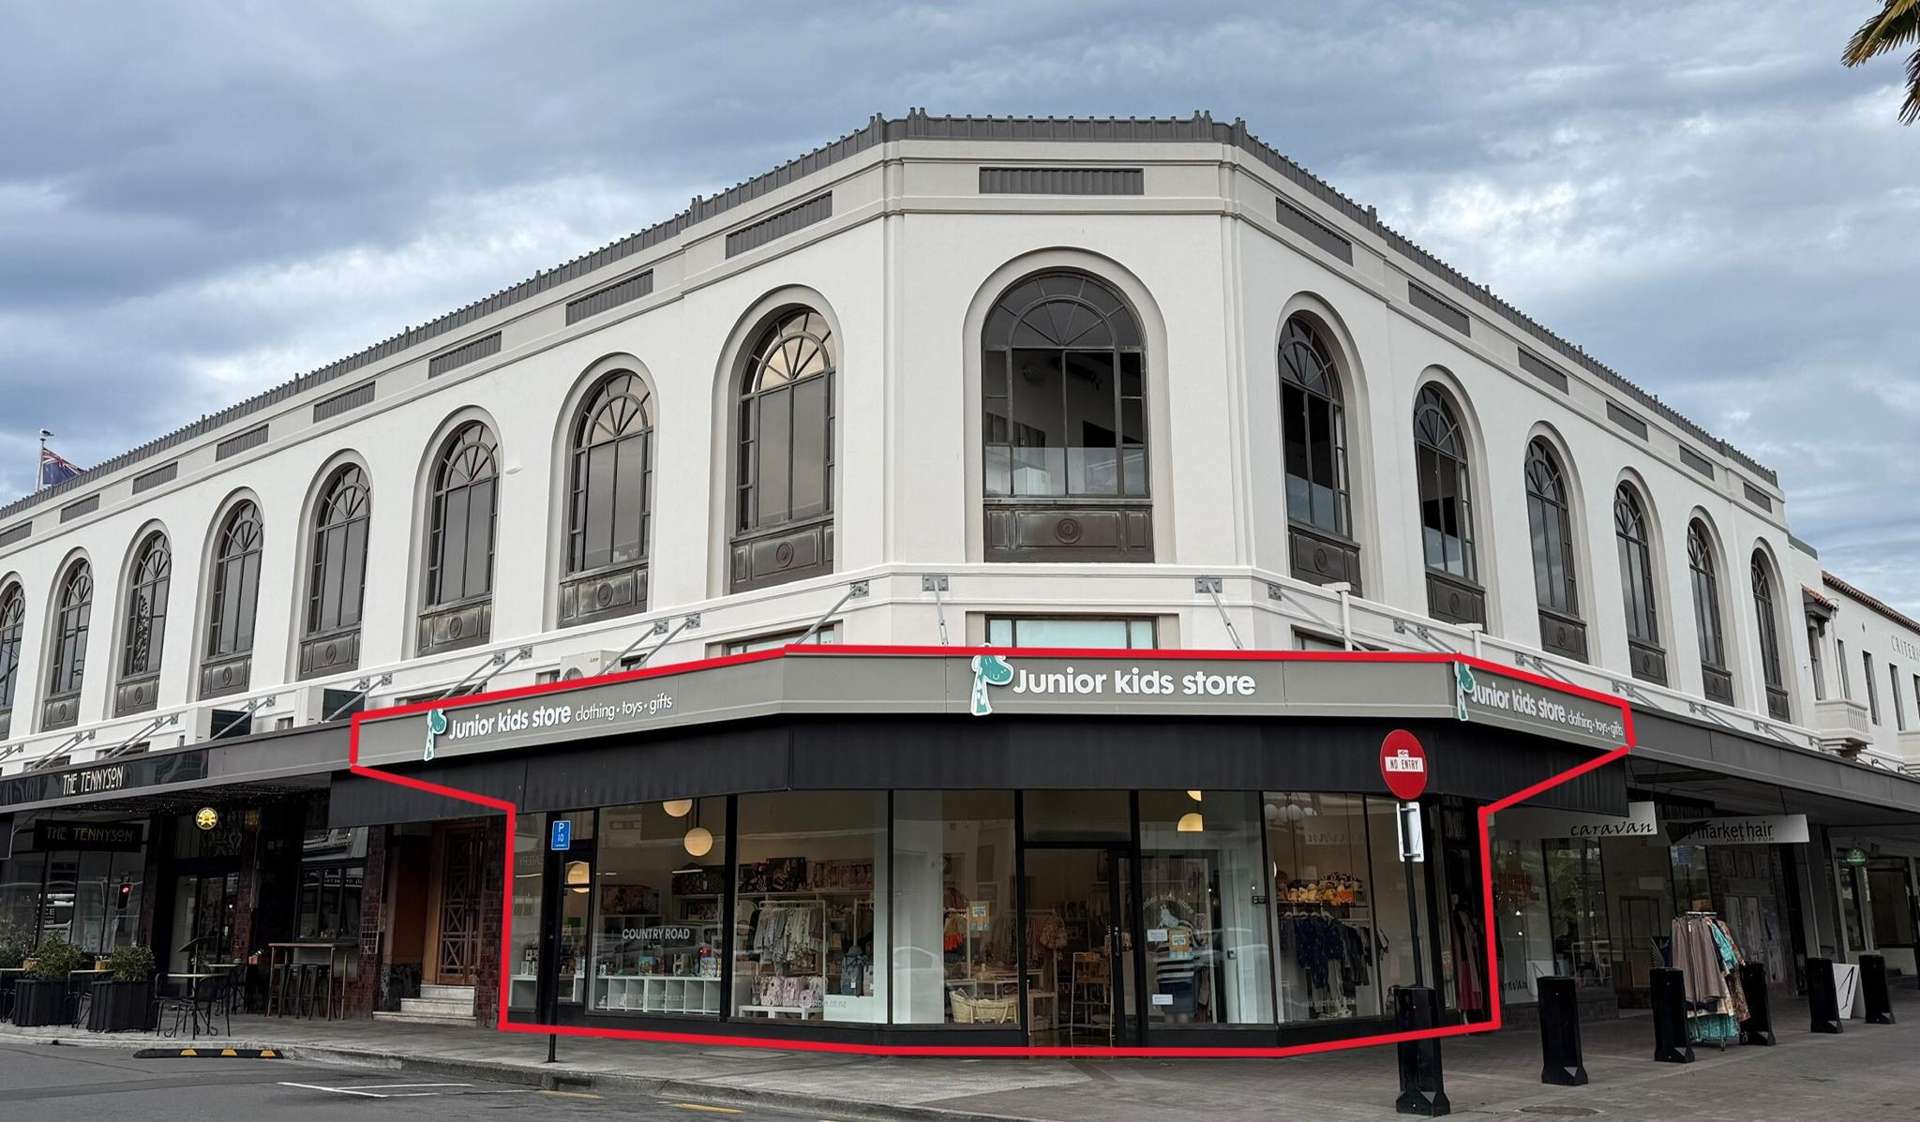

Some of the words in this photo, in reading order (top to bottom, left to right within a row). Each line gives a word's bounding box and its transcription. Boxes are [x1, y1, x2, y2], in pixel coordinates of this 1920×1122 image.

[1013, 667, 1106, 694] Junior
[1115, 667, 1174, 695] kids
[1182, 671, 1256, 695] store
[1472, 682, 1511, 709] Junior
[1512, 689, 1537, 716] kids
[1538, 696, 1566, 723] store
[449, 711, 496, 740] Junior
[498, 708, 529, 733] kids
[532, 705, 571, 727] store
[575, 702, 615, 721] clothing
[622, 701, 643, 717] toys
[649, 693, 673, 714] gifts
[1390, 759, 1398, 769] NO
[1401, 759, 1418, 770] ENTRY
[63, 773, 77, 795] THE
[81, 766, 123, 793] TENNYSON
[47, 826, 66, 840] THE
[73, 827, 135, 842] TENNYSON
[559, 822, 565, 832] P
[1570, 821, 1653, 836] caravan
[1746, 821, 1773, 838] hair
[622, 928, 664, 940] COUNTRY
[665, 928, 690, 940] ROAD
